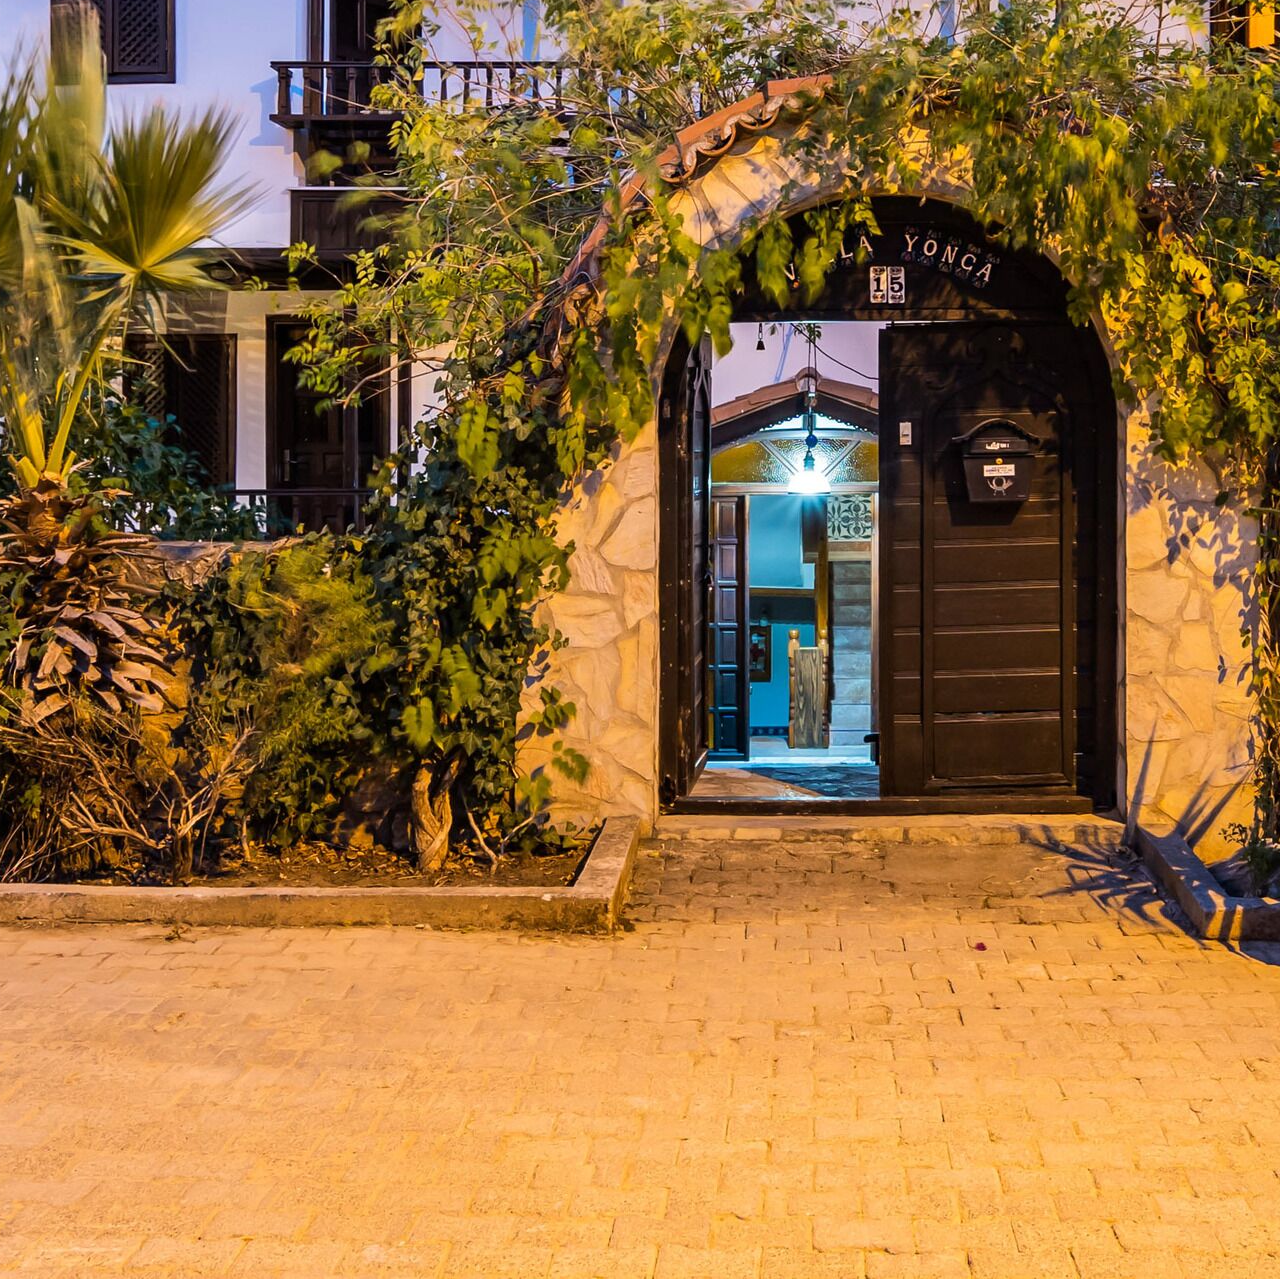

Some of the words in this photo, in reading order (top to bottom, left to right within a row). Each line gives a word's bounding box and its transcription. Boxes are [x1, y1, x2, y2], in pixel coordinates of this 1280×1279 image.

[783, 235, 873, 280] VLA
[904, 233, 992, 281] YONCA
[873, 274, 903, 293] 15
